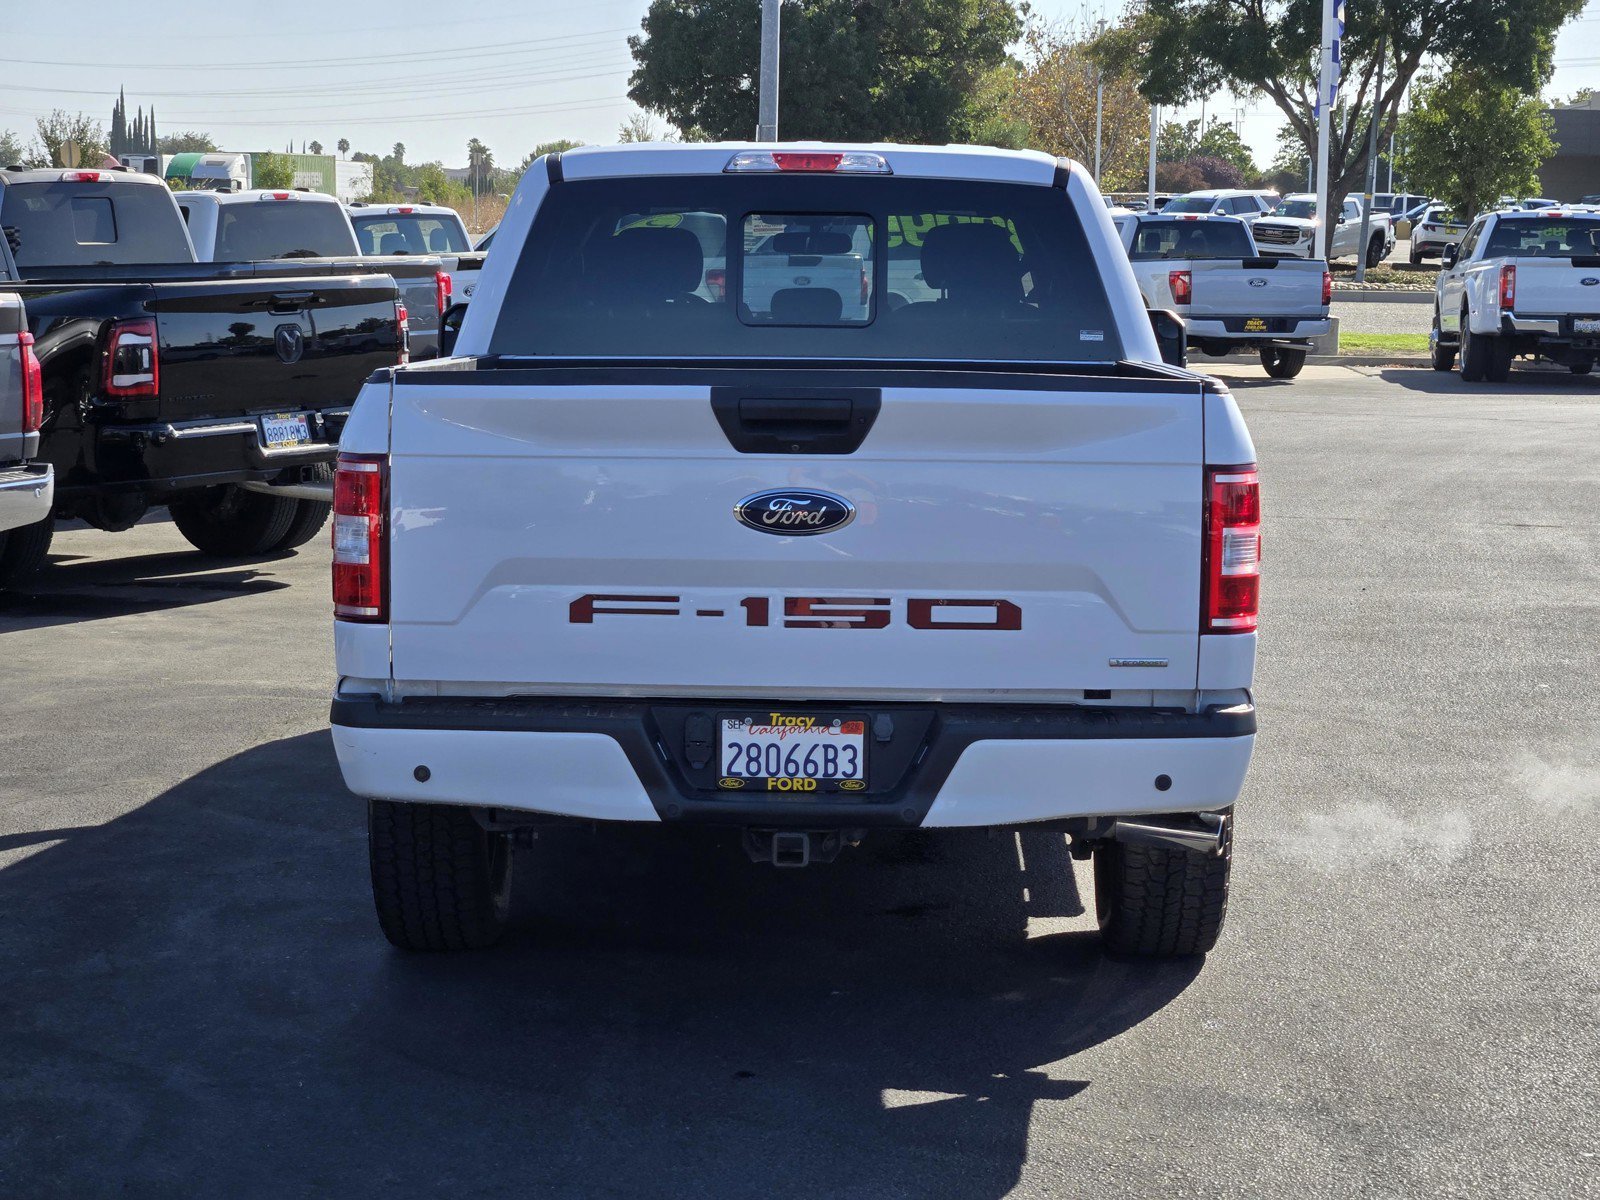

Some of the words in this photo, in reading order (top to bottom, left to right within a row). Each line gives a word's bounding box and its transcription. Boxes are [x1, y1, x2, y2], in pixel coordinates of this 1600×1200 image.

[266, 424, 308, 442] 88818M3
[762, 498, 826, 525] Ford
[569, 594, 1022, 630] F-150
[727, 719, 743, 730] SEP
[769, 713, 816, 729] Tracy
[748, 724, 841, 741] California
[726, 742, 858, 778] 28066B3
[767, 777, 817, 791] FORD
